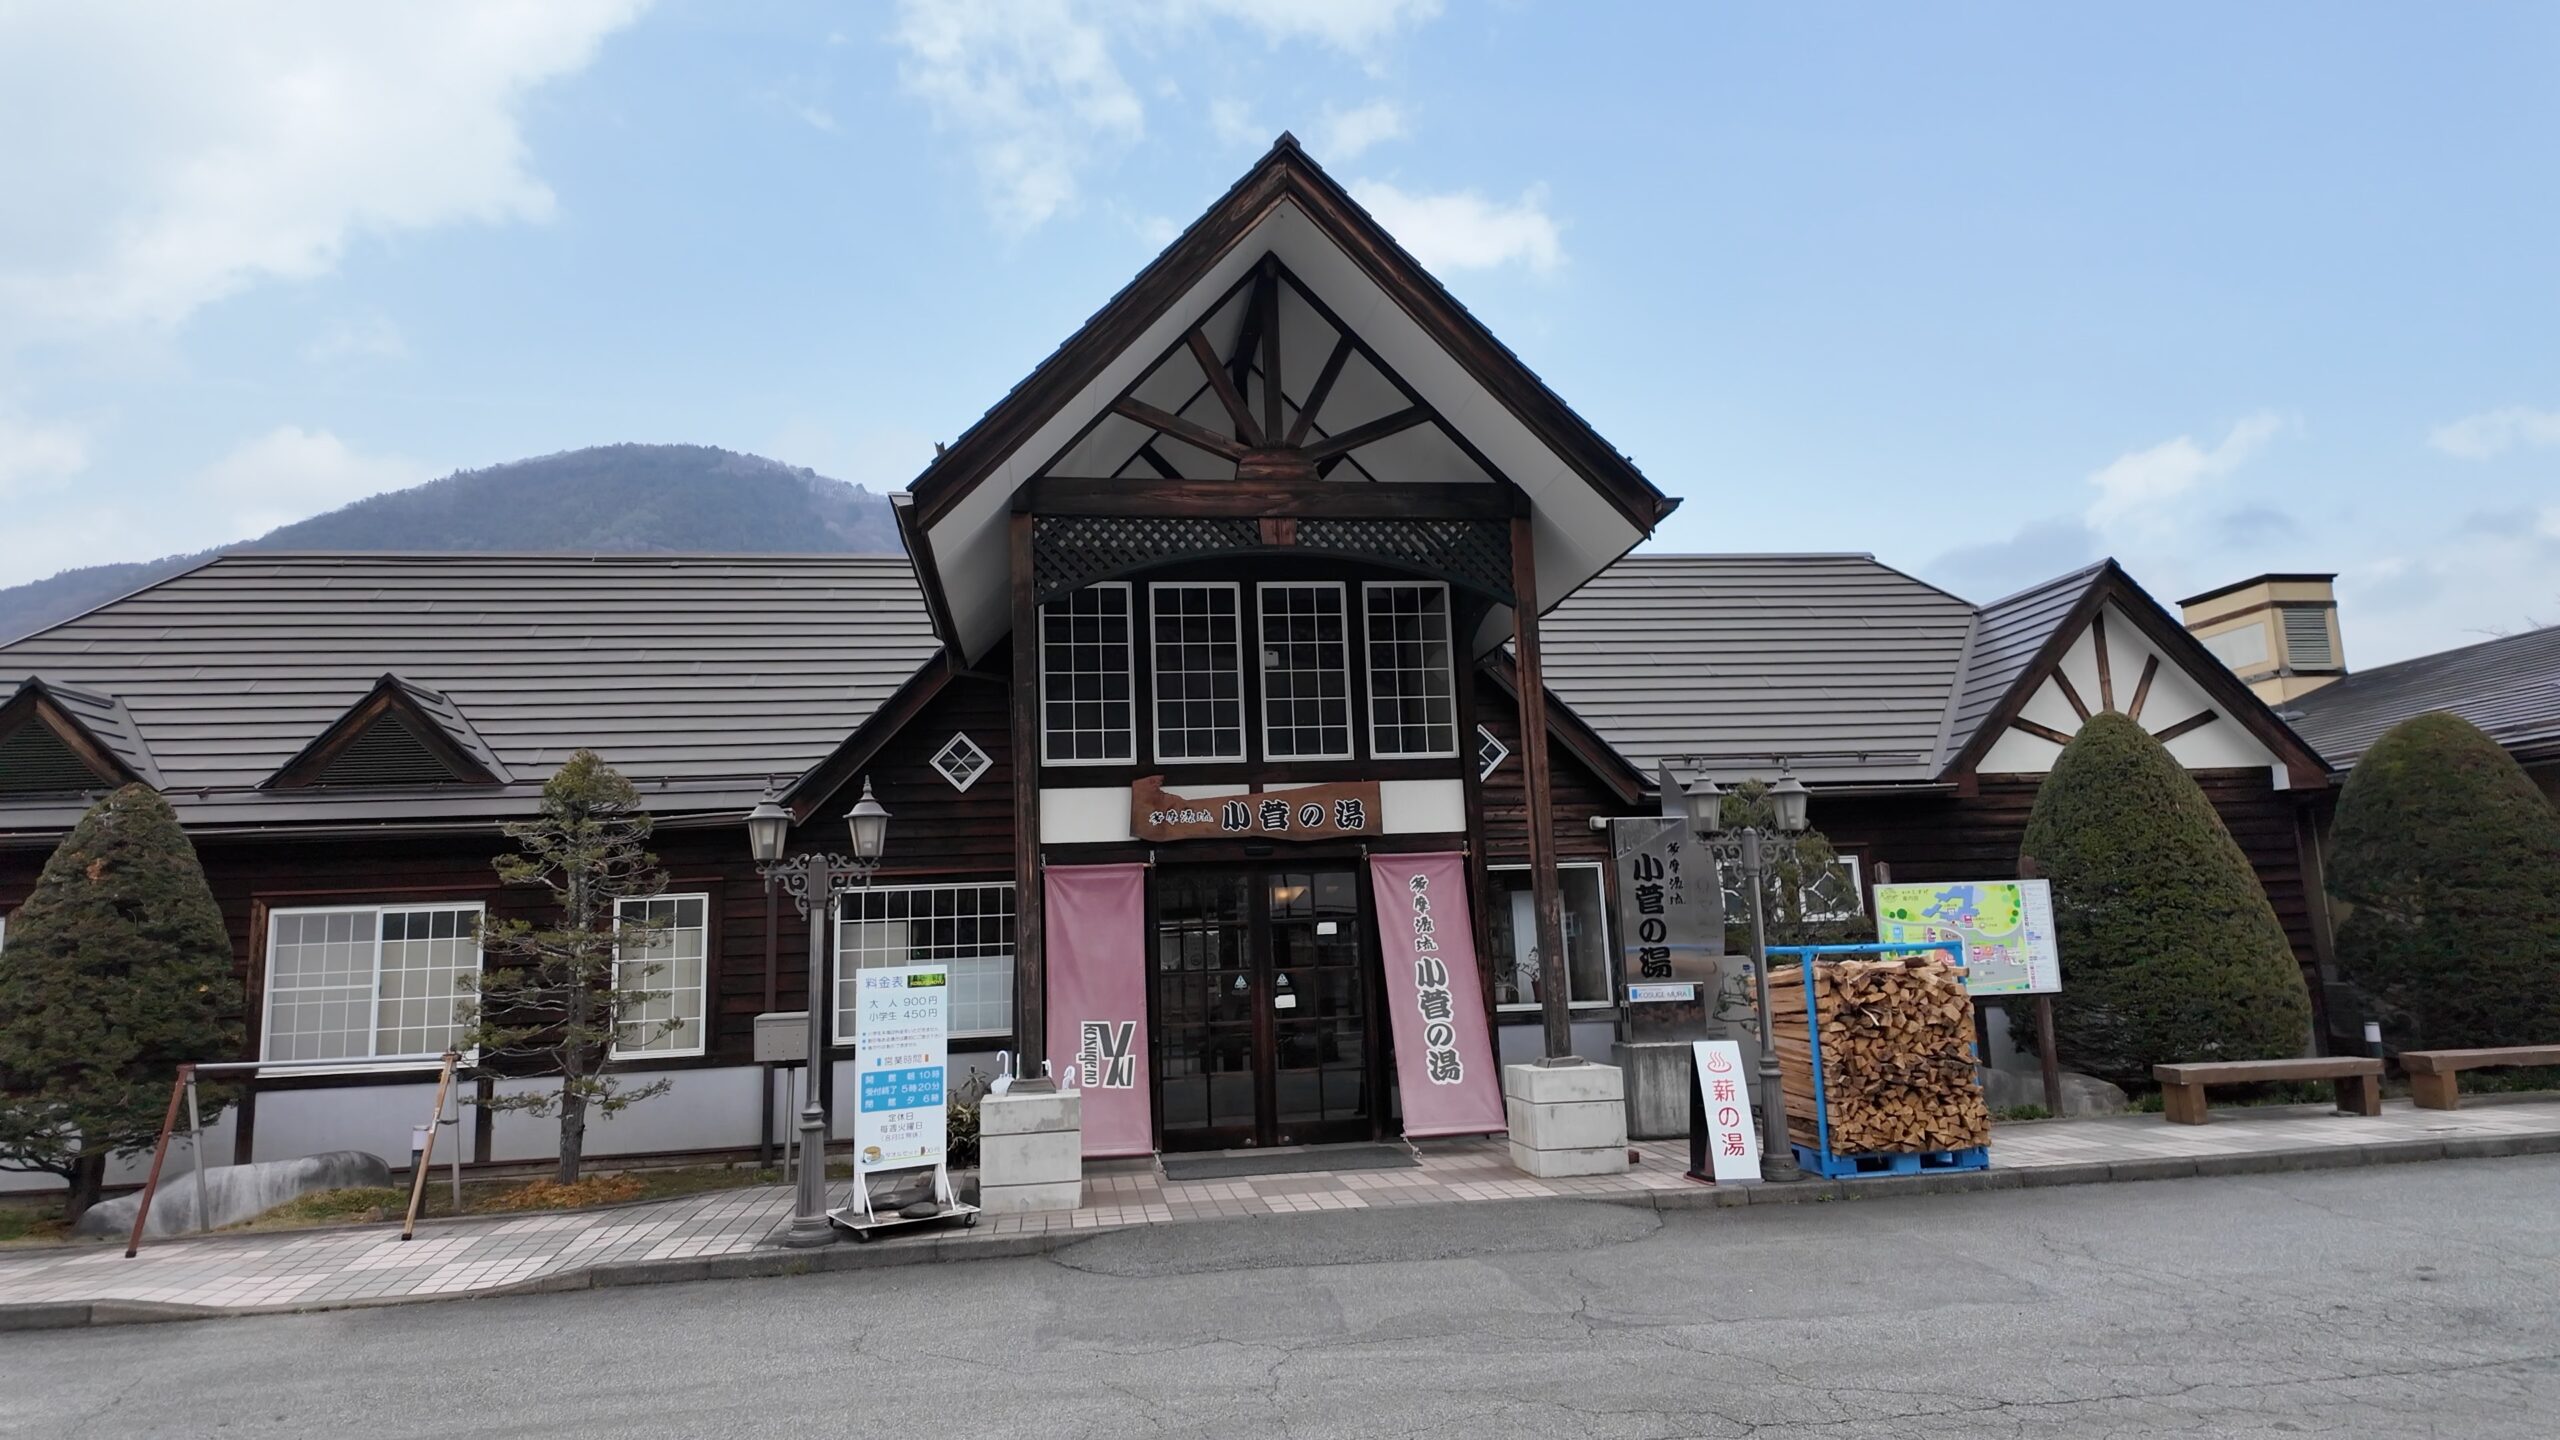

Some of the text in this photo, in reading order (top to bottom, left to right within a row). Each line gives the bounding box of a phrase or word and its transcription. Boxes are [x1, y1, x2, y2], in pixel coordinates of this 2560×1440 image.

[1222, 799, 1365, 831] 小菅の湯
[1633, 852, 1673, 979] 小菅の湯
[865, 976, 903, 989] 料金表
[1409, 874, 1464, 1085] 多摩源流 小菅の湯
[903, 995, 938, 1007] 900円
[869, 1008, 938, 1022] 小学生 450円
[884, 1054, 922, 1066] 営業時間
[888, 1112, 913, 1122] 定休日
[1712, 1079, 1745, 1157] 薪の湯
[880, 1122, 923, 1133] 毎週火曜日
